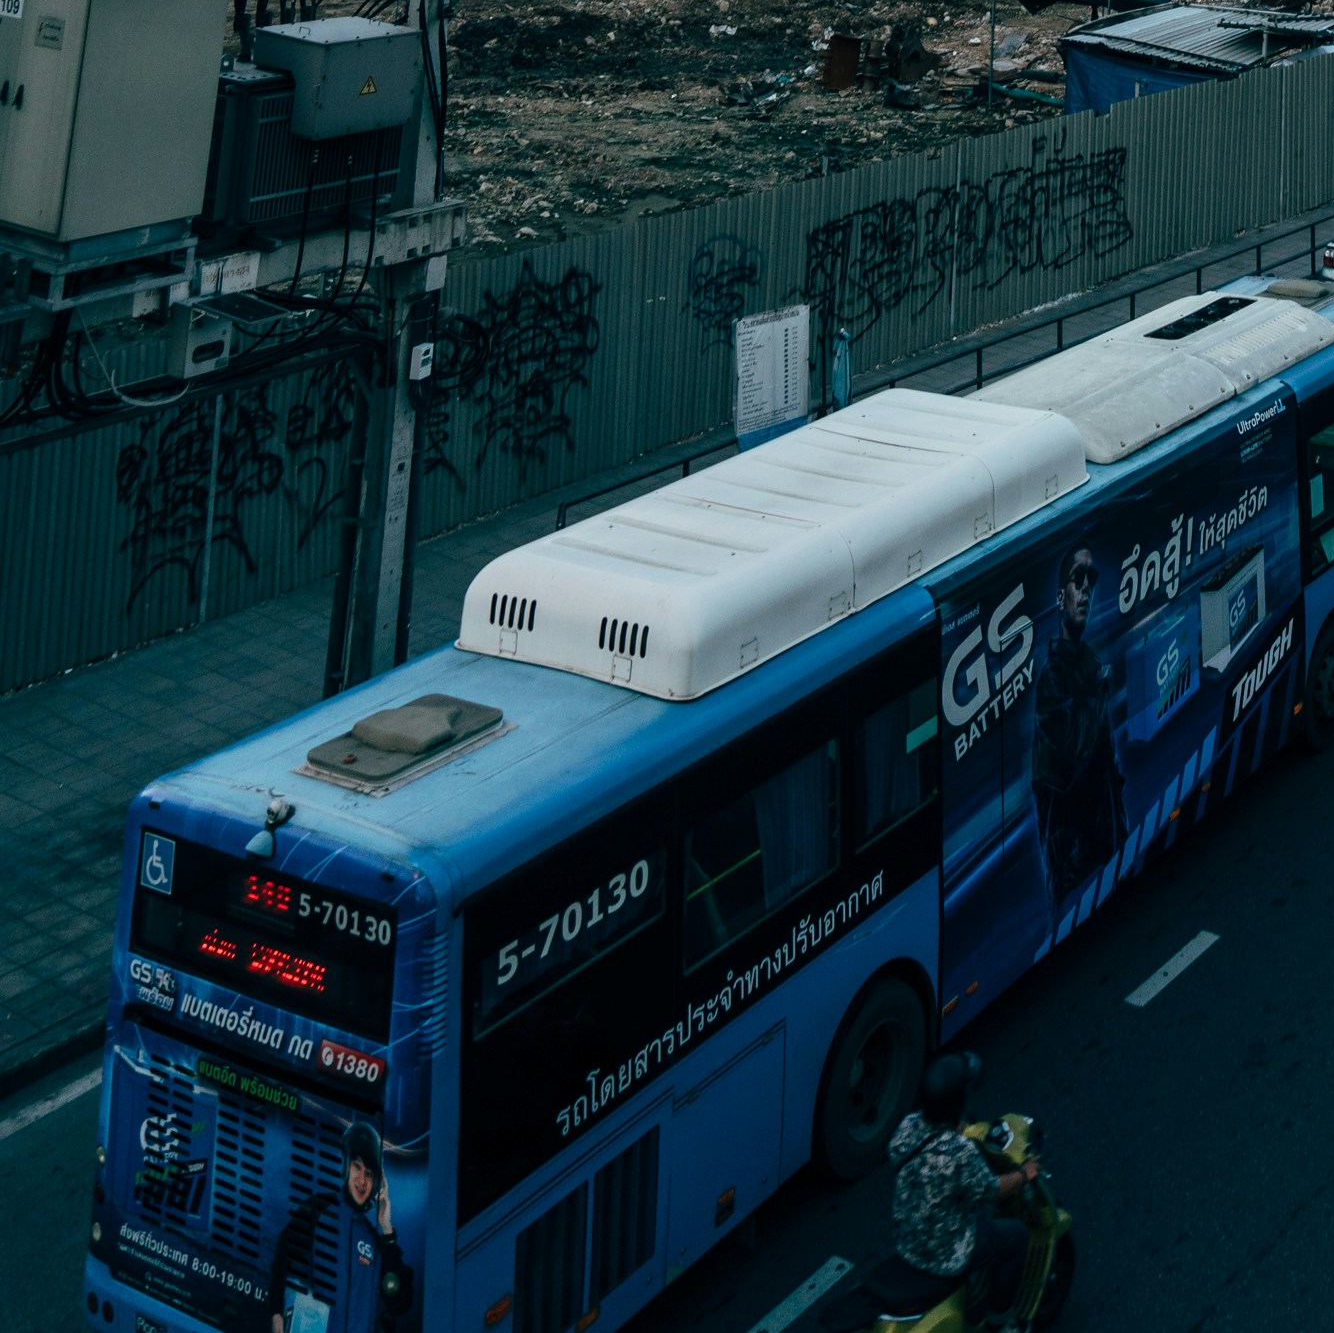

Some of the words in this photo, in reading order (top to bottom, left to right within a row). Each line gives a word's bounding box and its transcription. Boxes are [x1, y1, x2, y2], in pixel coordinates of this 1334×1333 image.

[1199, 486, 1268, 556] ให้สุดชีวิต
[1229, 589, 1246, 628] GS
[942, 582, 1034, 726] GS
[1156, 637, 1179, 686] GS
[1232, 617, 1294, 722] TOUGH
[954, 659, 1034, 762] BATTERY
[298, 893, 392, 946] 5-70130
[497, 859, 650, 986] 5-70130
[130, 959, 152, 984] GS
[556, 870, 885, 1137] รถโดยสารประจำทางปรับอากาศ
[180, 992, 285, 1051] แบตเตอรี่หมด
[287, 1034, 314, 1061] กด
[336, 1053, 380, 1083] 1380
[240, 1072, 299, 1111] พร้อมช่วย
[191, 1256, 253, 1296] 8:00-19:00
